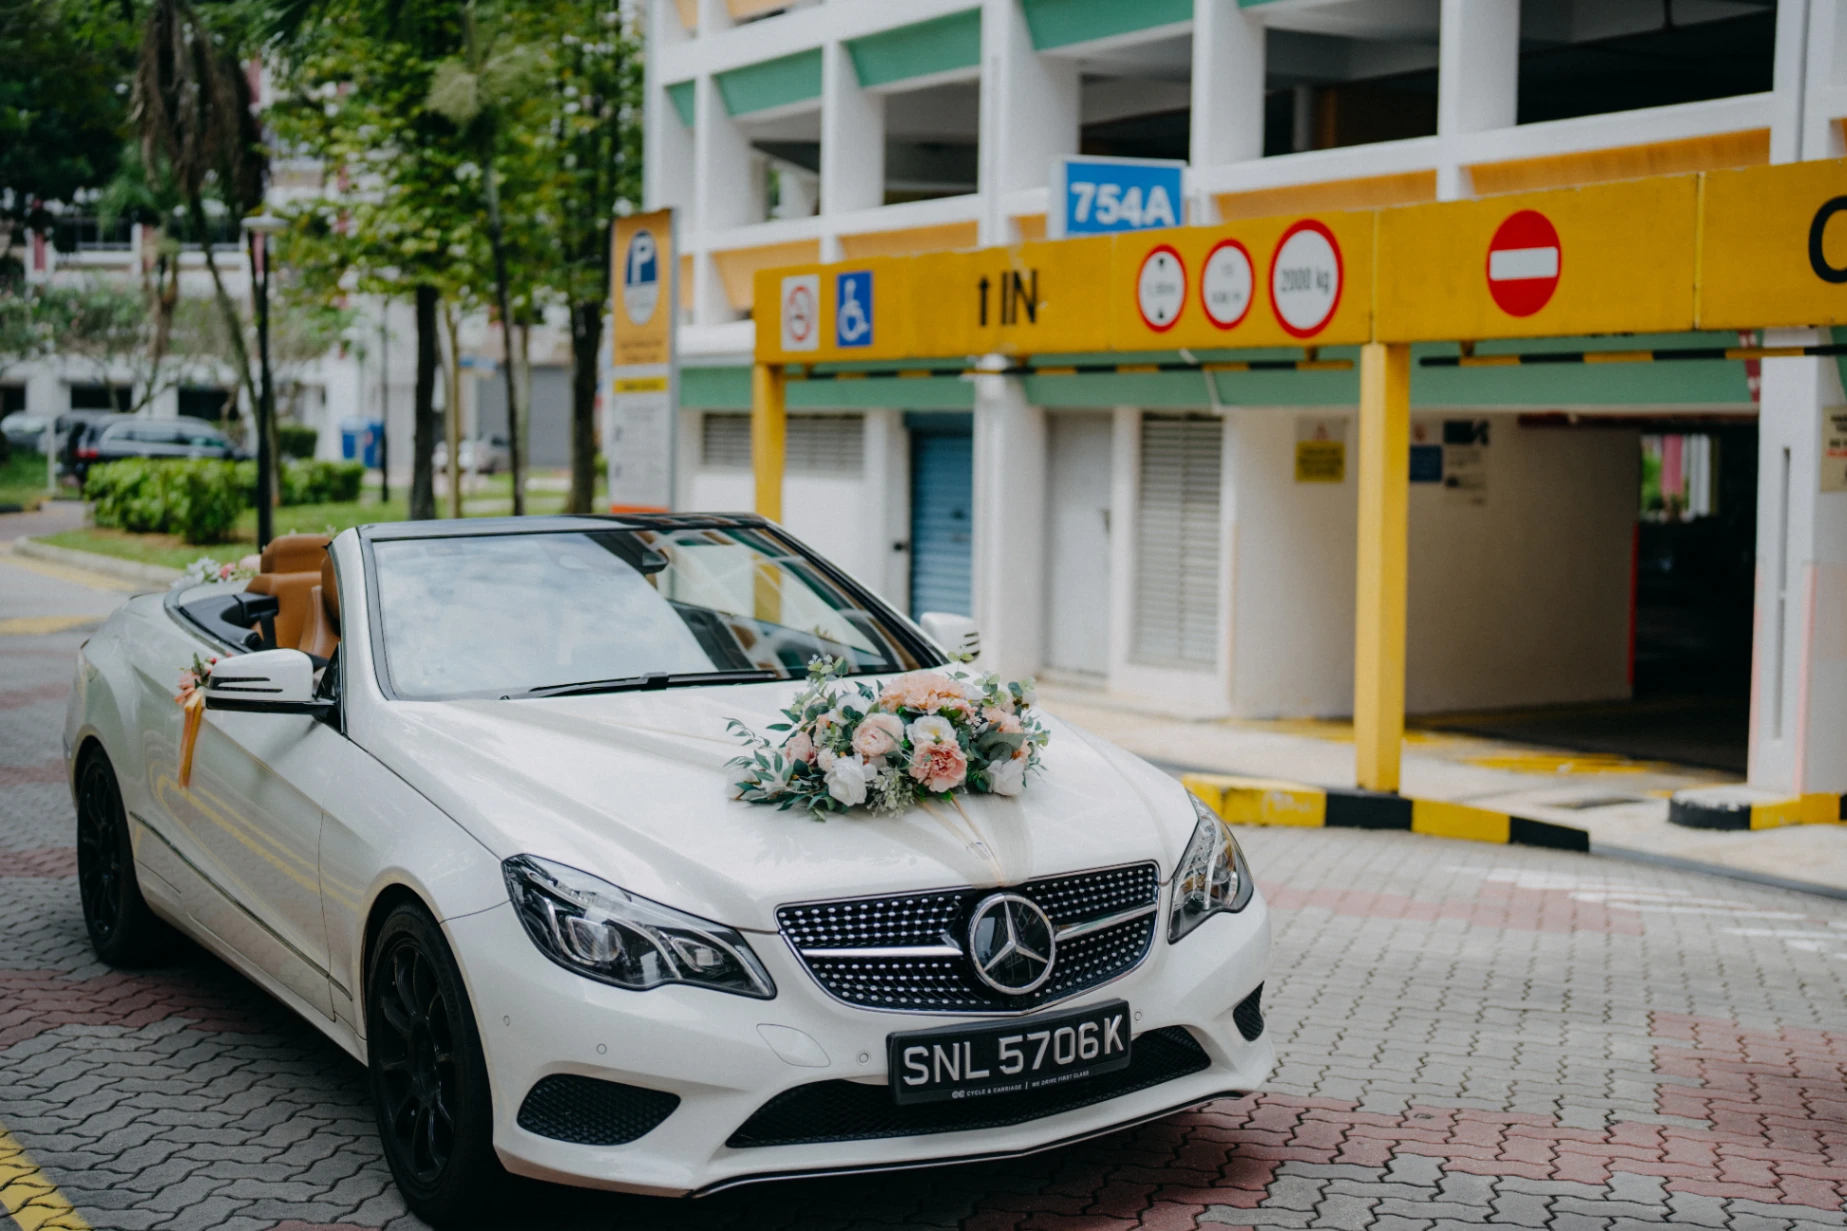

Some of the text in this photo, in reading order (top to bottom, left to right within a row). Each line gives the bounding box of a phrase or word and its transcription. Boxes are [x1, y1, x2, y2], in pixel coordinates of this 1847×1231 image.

[1070, 181, 1176, 228] 754A
[631, 233, 655, 284] P
[1316, 265, 1330, 297] kg
[1001, 269, 1038, 326] IN
[903, 1014, 1124, 1086] SNL 5706K
[966, 1088, 986, 1097] CYCLE
[993, 1084, 1022, 1093] CARRIAGE
[1041, 1077, 1057, 1086] DRIVE
[1057, 1073, 1073, 1082] FIRST
[1073, 1070, 1090, 1079] CLASS
